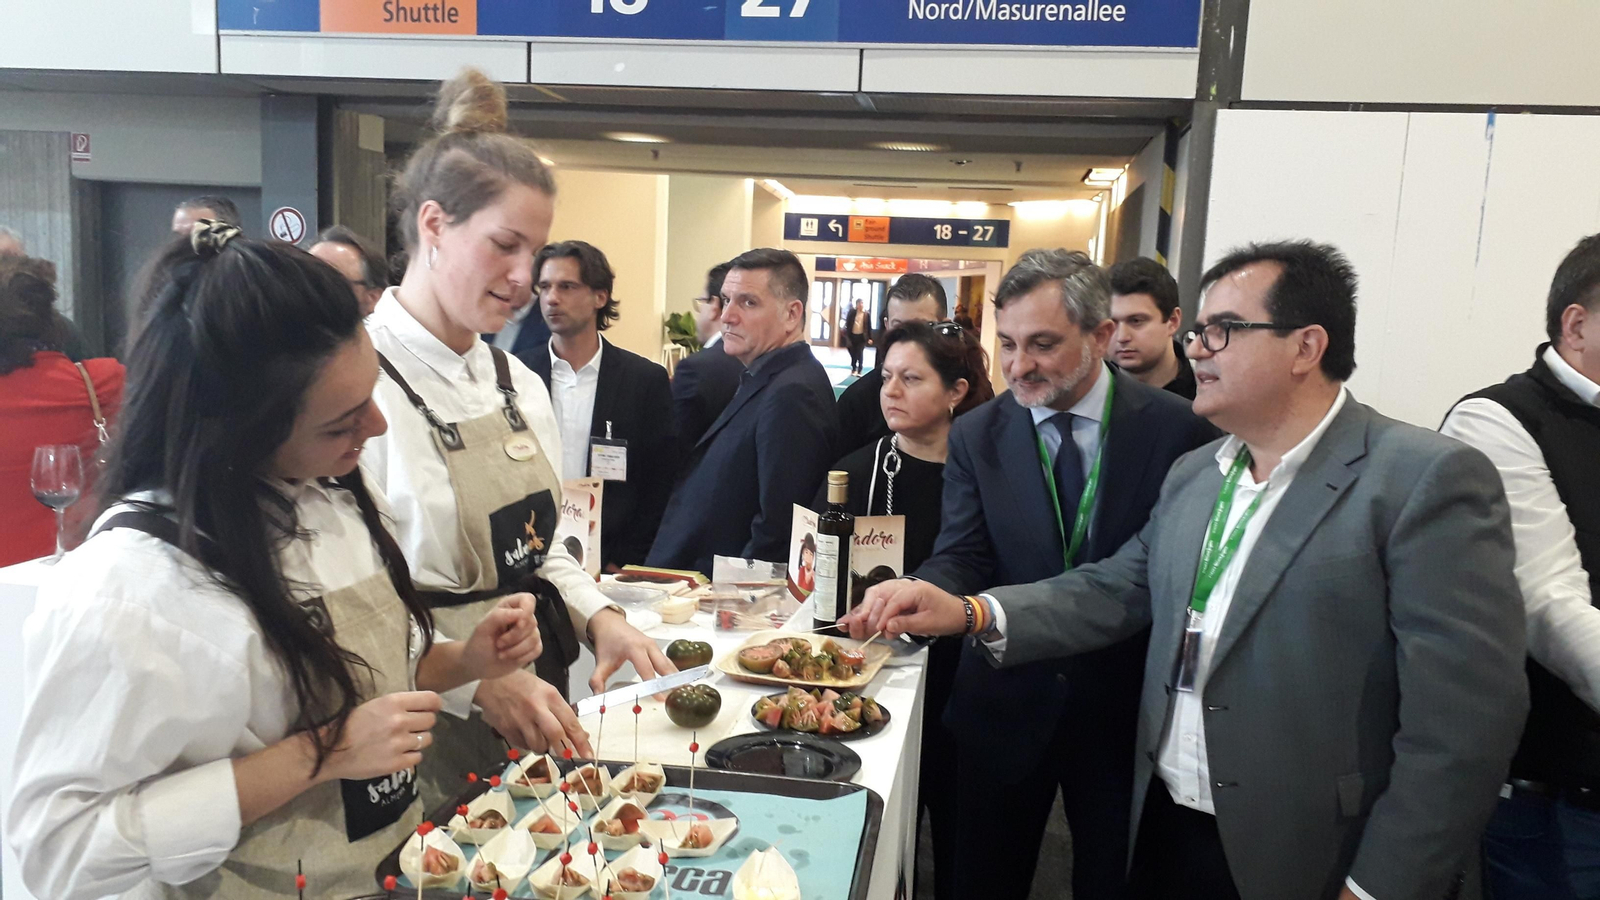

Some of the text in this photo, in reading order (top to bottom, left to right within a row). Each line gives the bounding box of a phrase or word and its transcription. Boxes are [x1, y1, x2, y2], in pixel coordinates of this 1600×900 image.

[382, 0, 460, 24] Shuttle
[908, 0, 1126, 22] Nord/Masurenallee
[934, 224, 952, 240] 18
[972, 225, 995, 241] 27
